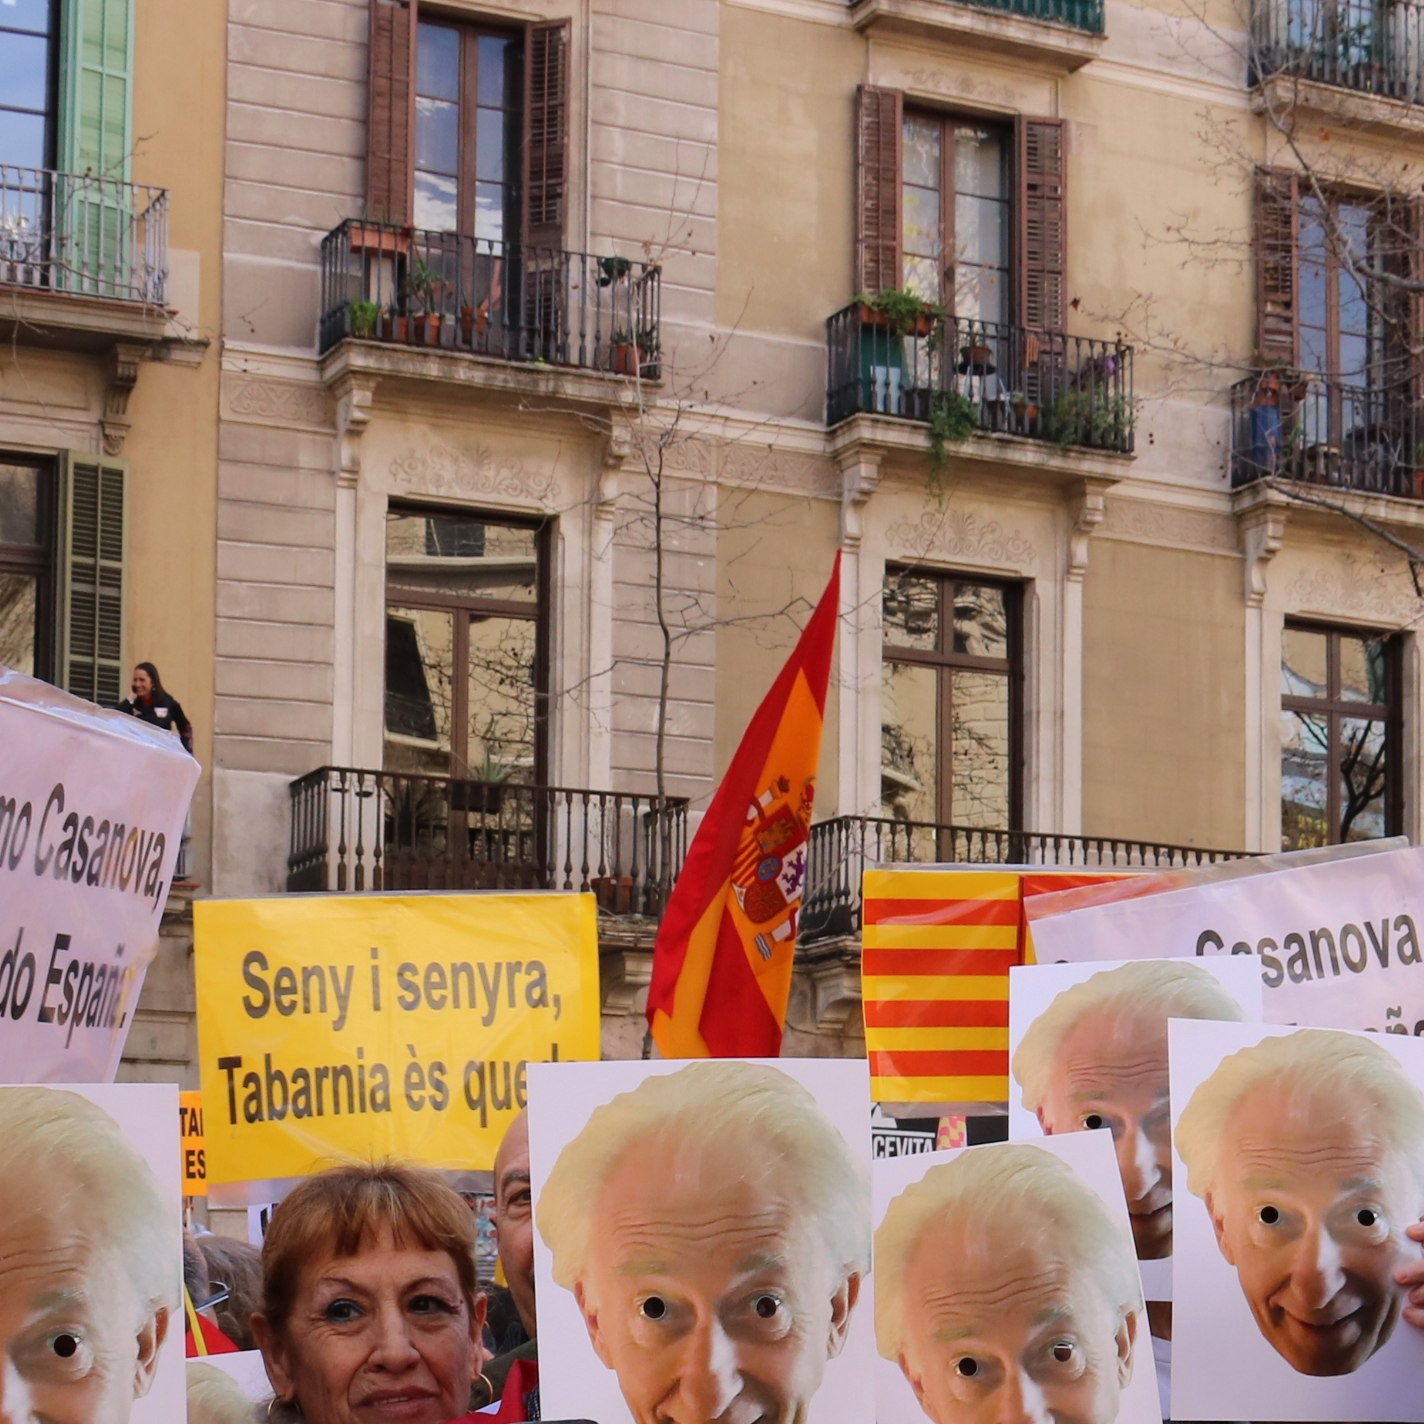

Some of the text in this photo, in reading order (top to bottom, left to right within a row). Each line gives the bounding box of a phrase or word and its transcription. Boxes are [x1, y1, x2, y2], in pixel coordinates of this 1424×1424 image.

[33, 782, 167, 911] Casanova,
[241, 946, 562, 1030] Seny i senyra,
[218, 1047, 389, 1125] Tabarnia
[404, 1044, 450, 1112] ès
